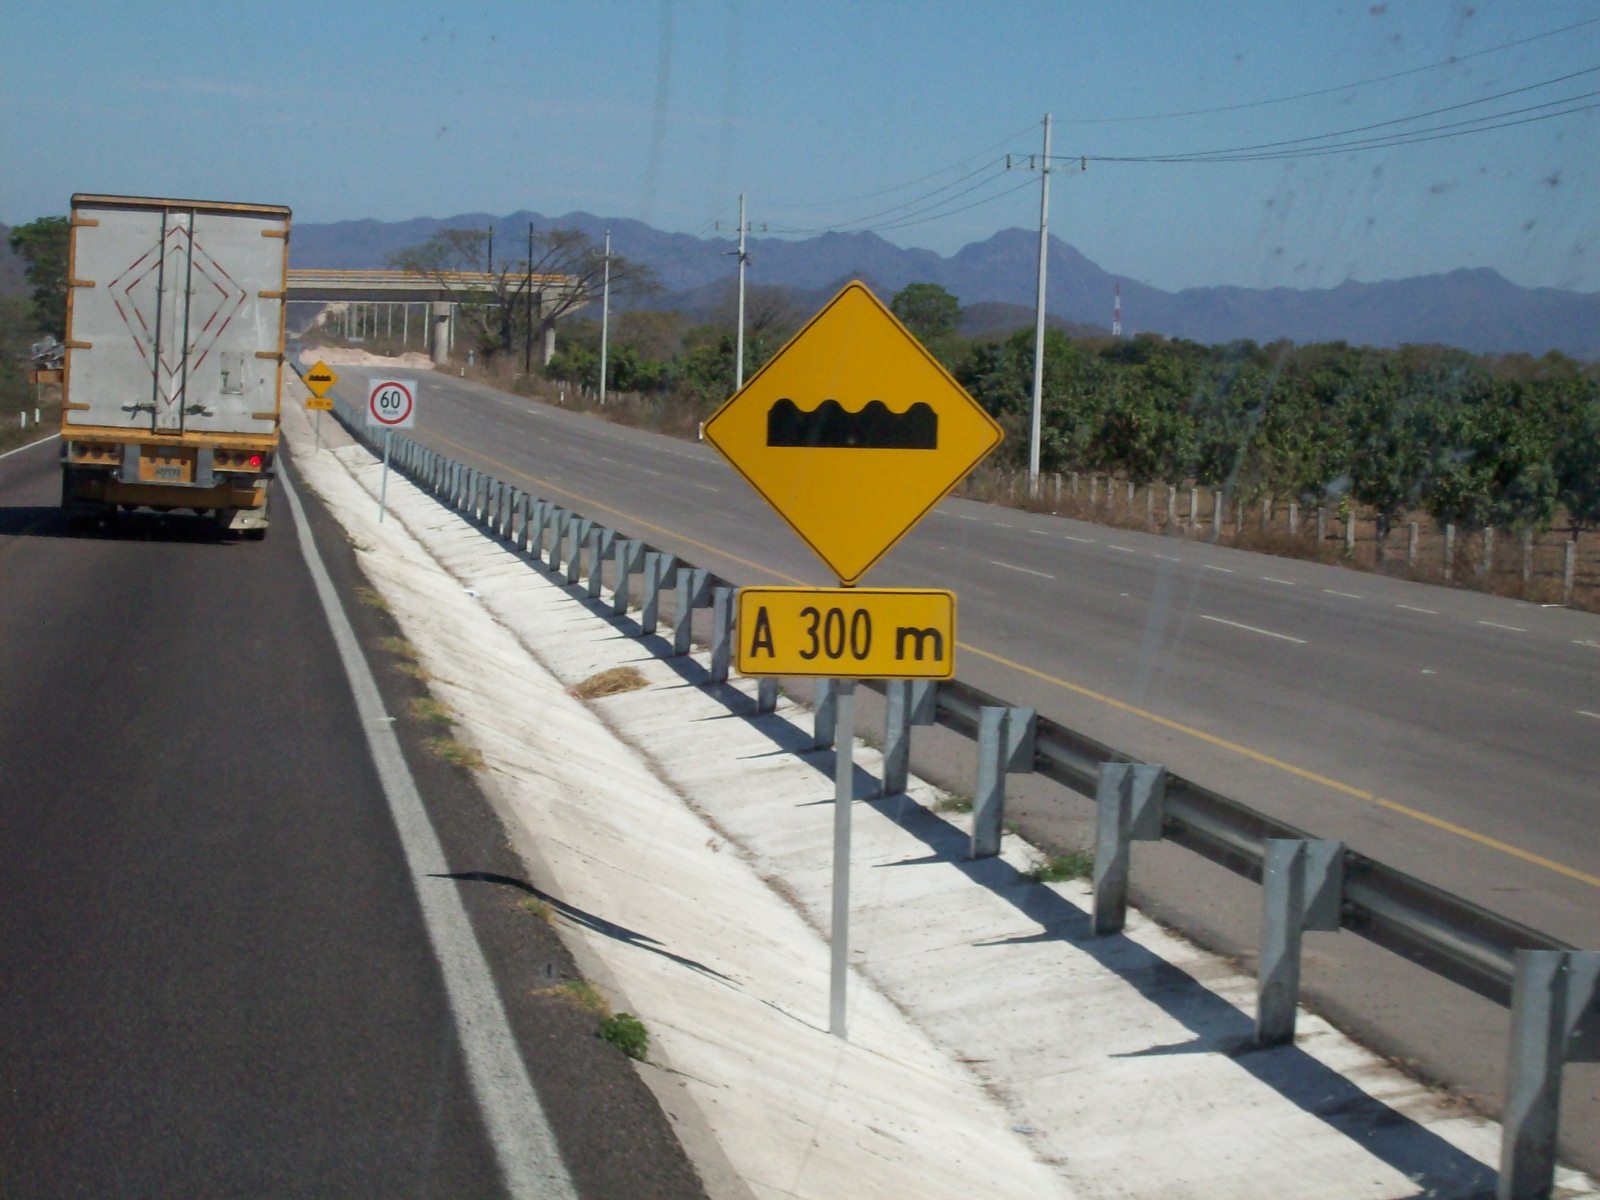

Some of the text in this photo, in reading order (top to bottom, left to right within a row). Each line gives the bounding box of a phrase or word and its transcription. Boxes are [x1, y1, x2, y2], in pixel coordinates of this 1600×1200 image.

[380, 390, 401, 409] 60
[750, 606, 943, 661] A 300 m
